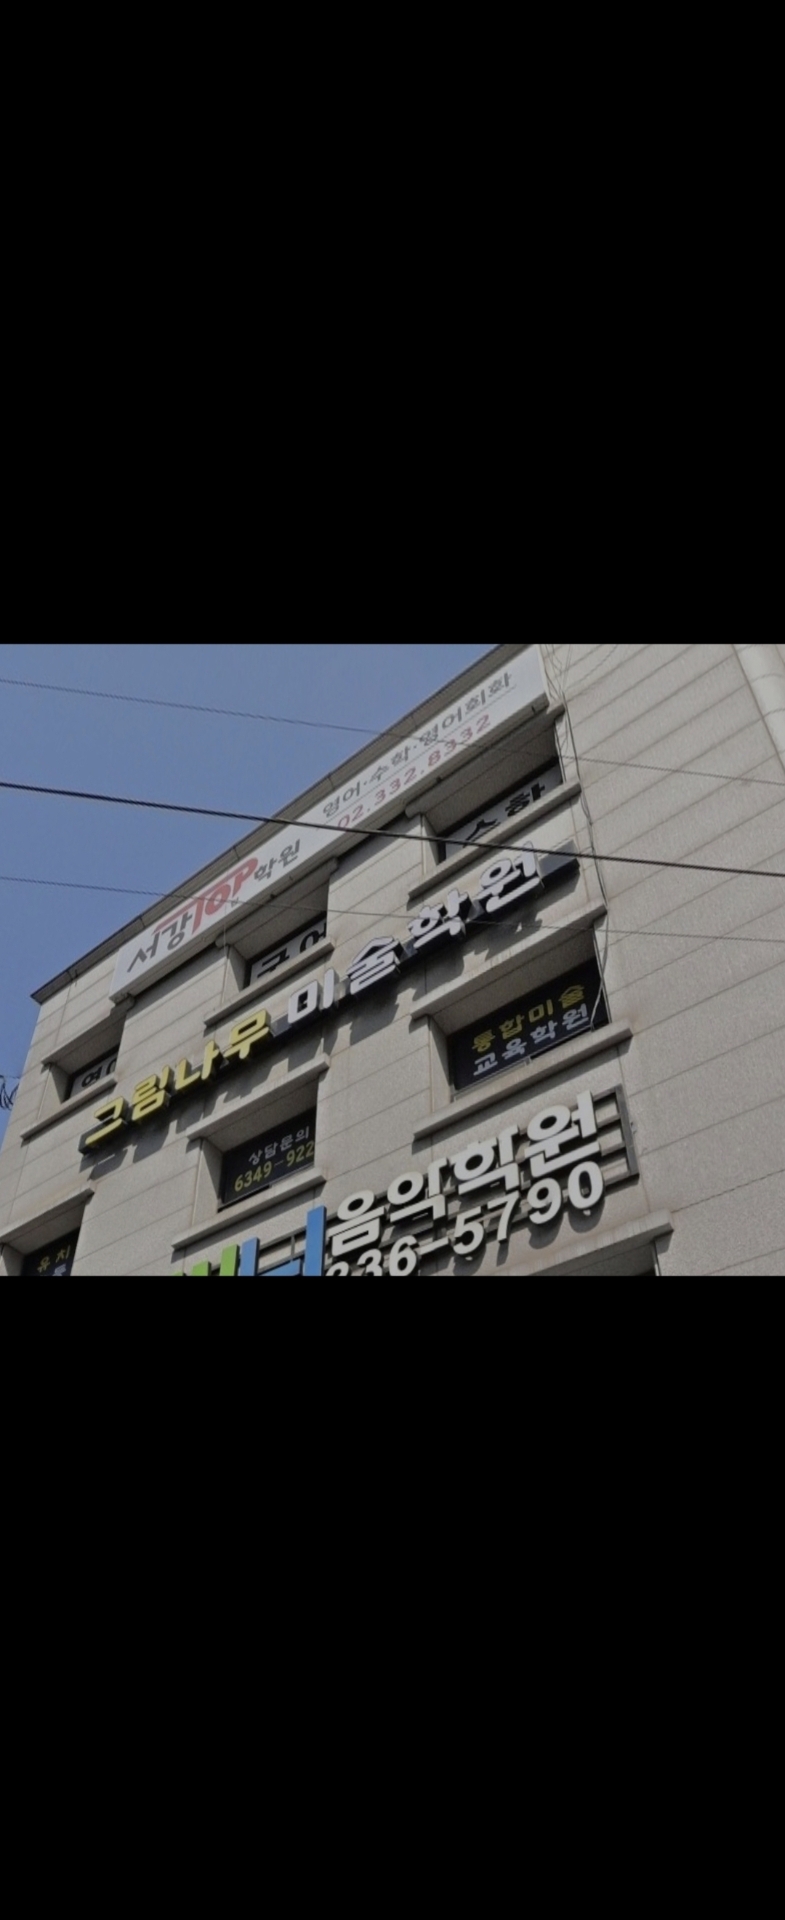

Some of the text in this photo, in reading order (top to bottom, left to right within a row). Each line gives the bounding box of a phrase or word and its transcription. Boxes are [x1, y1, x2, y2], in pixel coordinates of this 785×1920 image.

[85, 841, 542, 1146] 그림나무 미술학원
[473, 1003, 590, 1076] 교육학원
[248, 1125, 310, 1166] 상담문의
[327, 1089, 601, 1257] 음악학원
